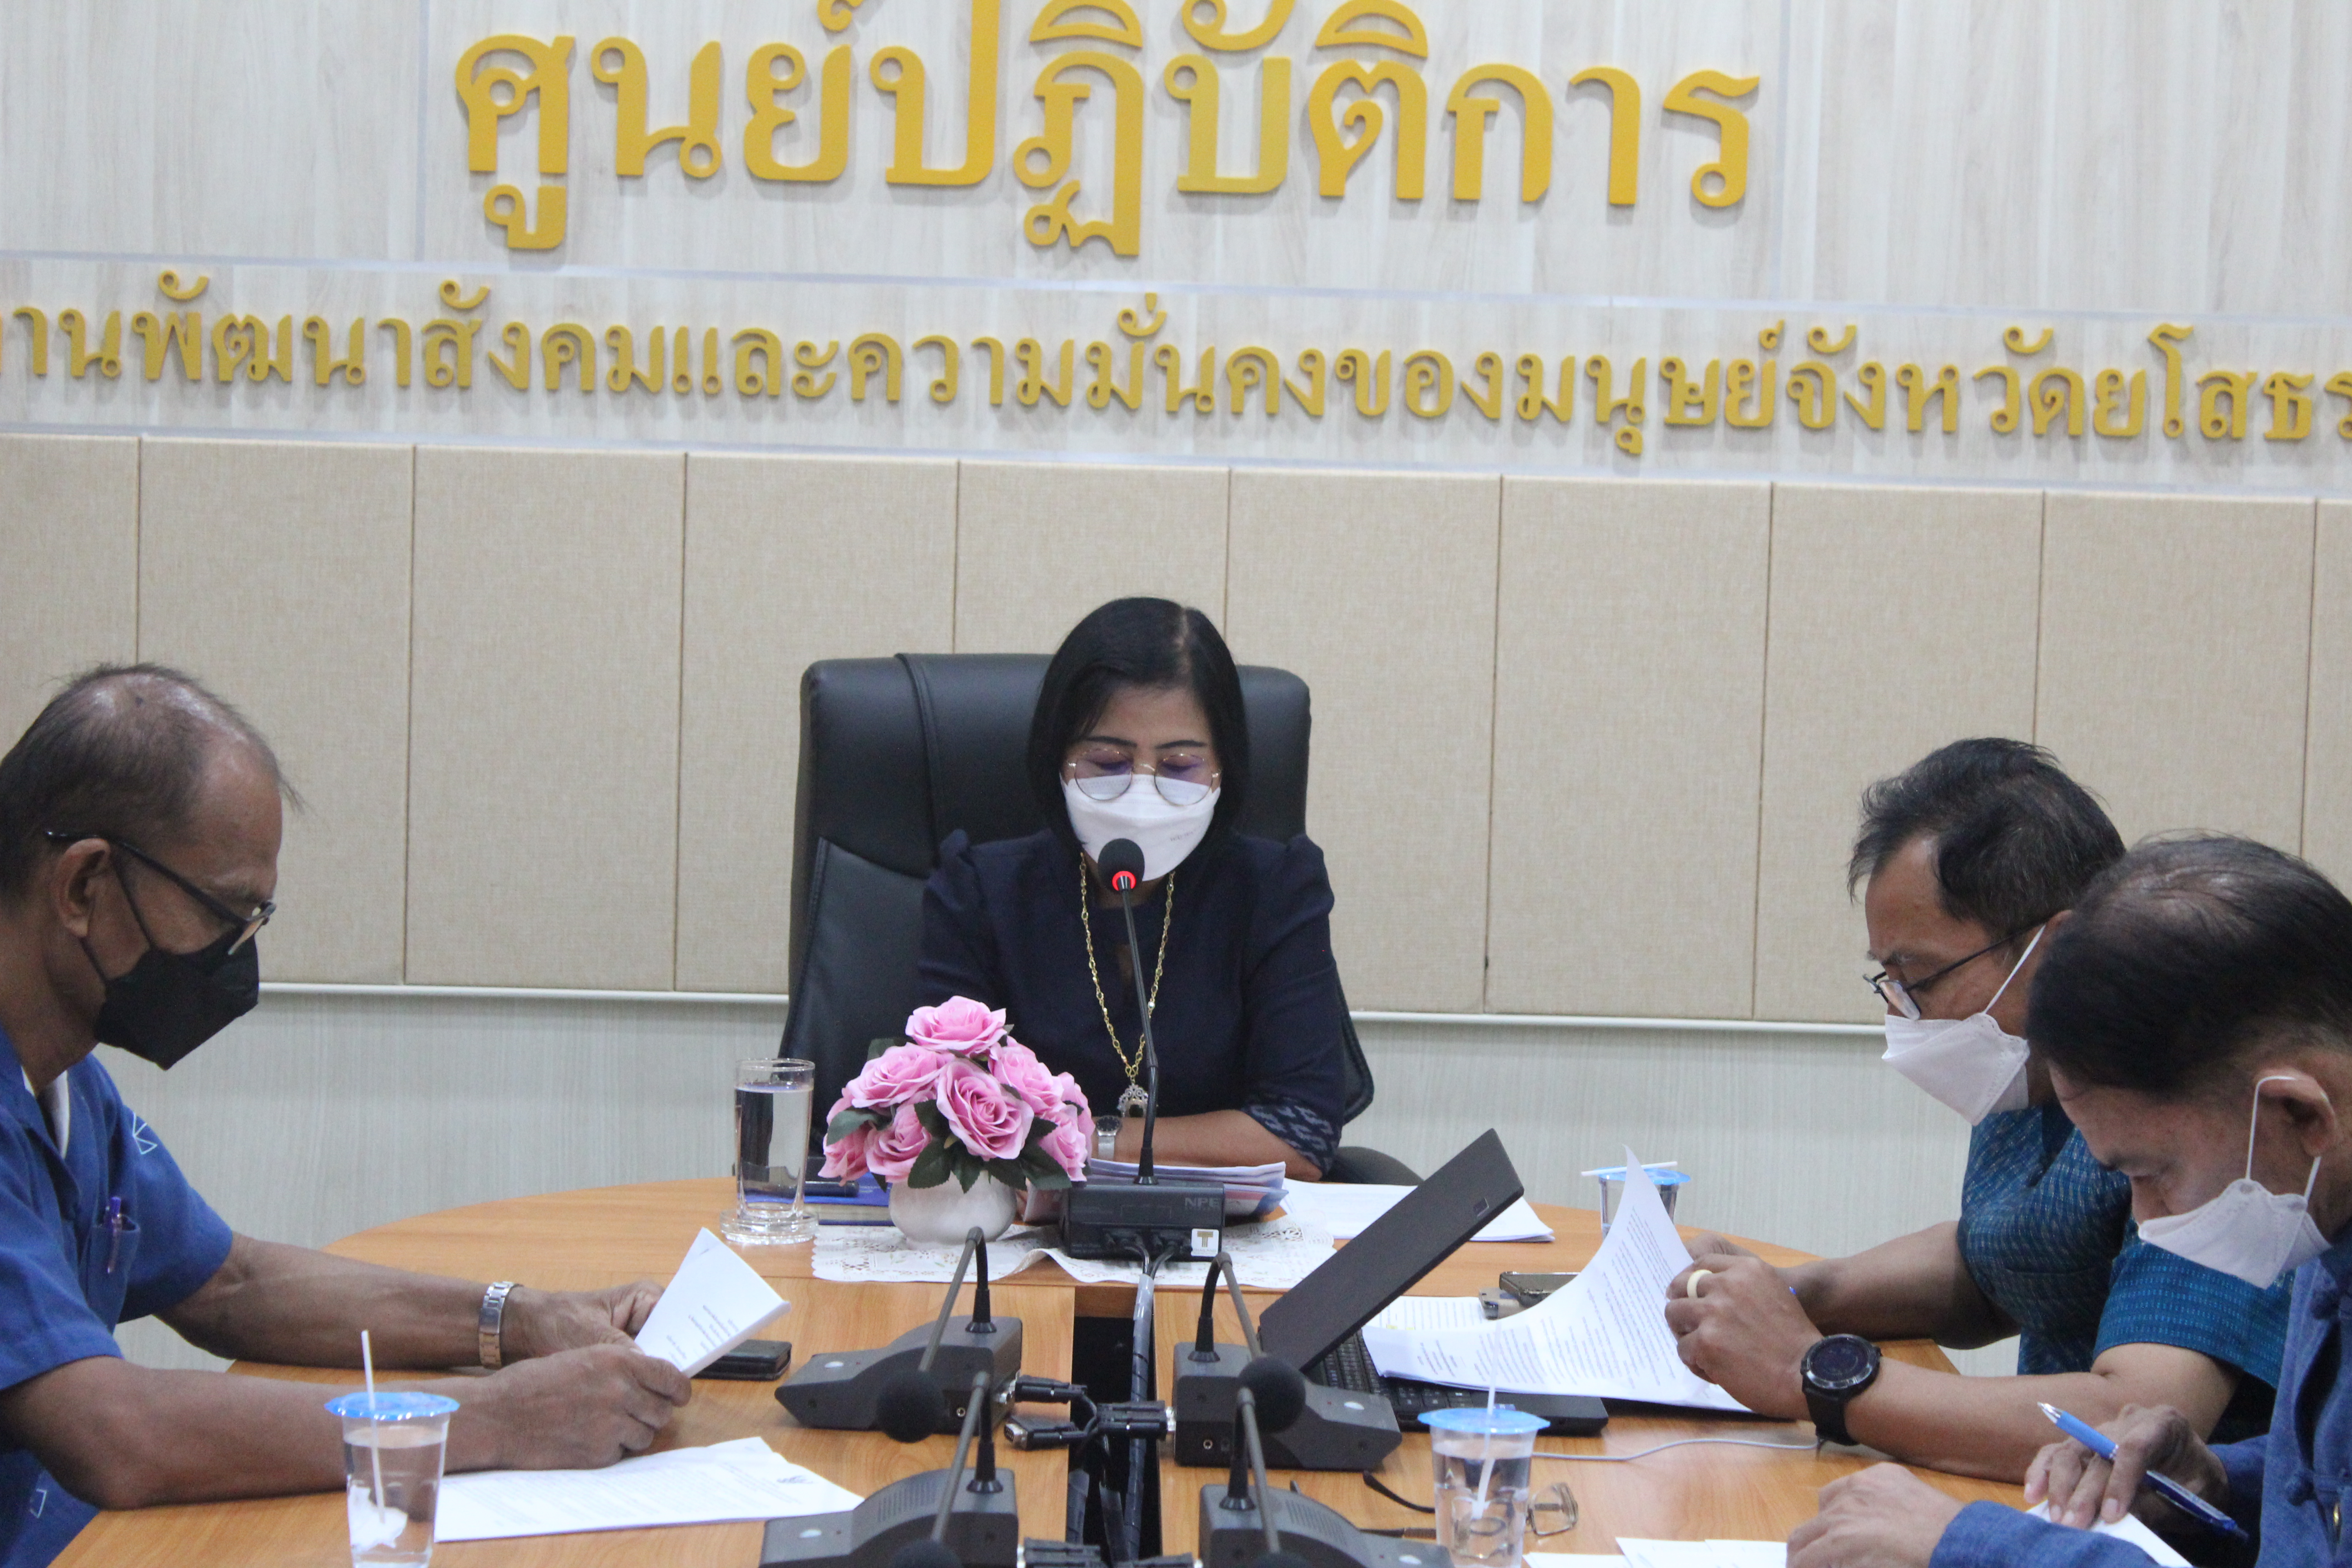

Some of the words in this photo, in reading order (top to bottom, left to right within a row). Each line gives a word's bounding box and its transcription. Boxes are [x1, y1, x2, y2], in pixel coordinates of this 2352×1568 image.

[0, 271, 2352, 454] านพัฒนาสังคมและความมั่นคงของมนุษย์จังหวัดยโสธร
